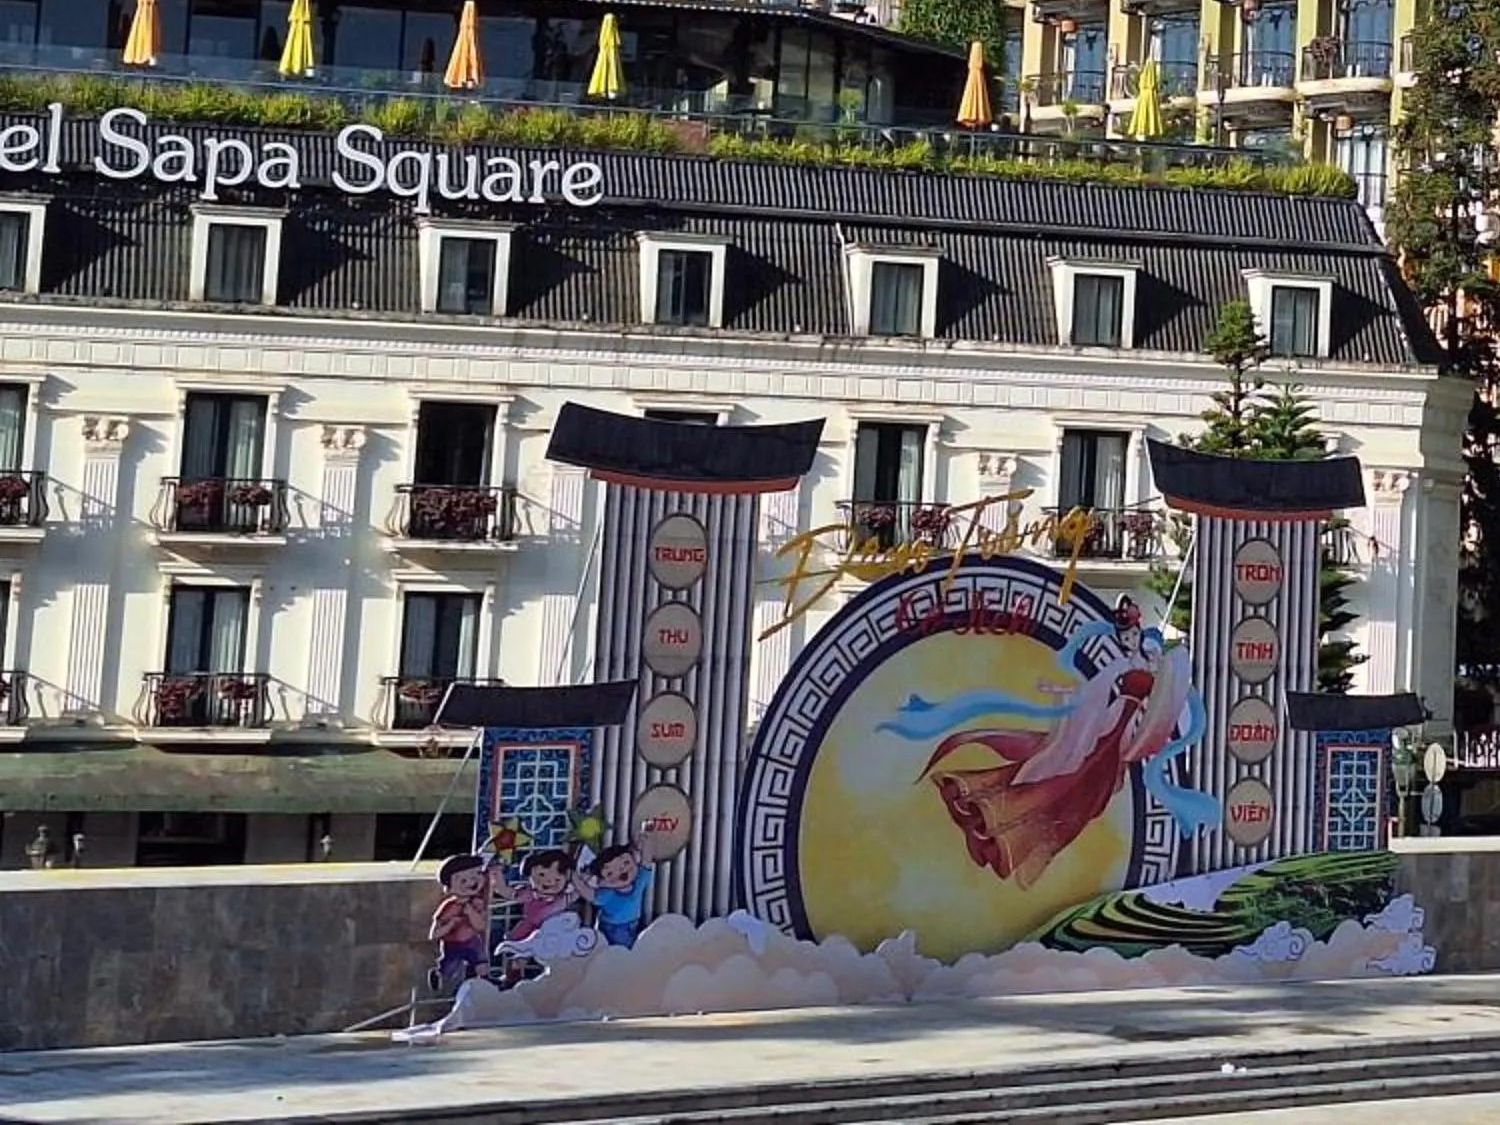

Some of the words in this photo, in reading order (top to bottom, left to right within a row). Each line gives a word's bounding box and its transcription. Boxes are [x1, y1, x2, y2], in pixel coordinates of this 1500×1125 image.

[94, 107, 301, 201] Sapa
[332, 124, 603, 213] Square
[654, 545, 705, 562] TRUNG
[658, 628, 689, 644] THU
